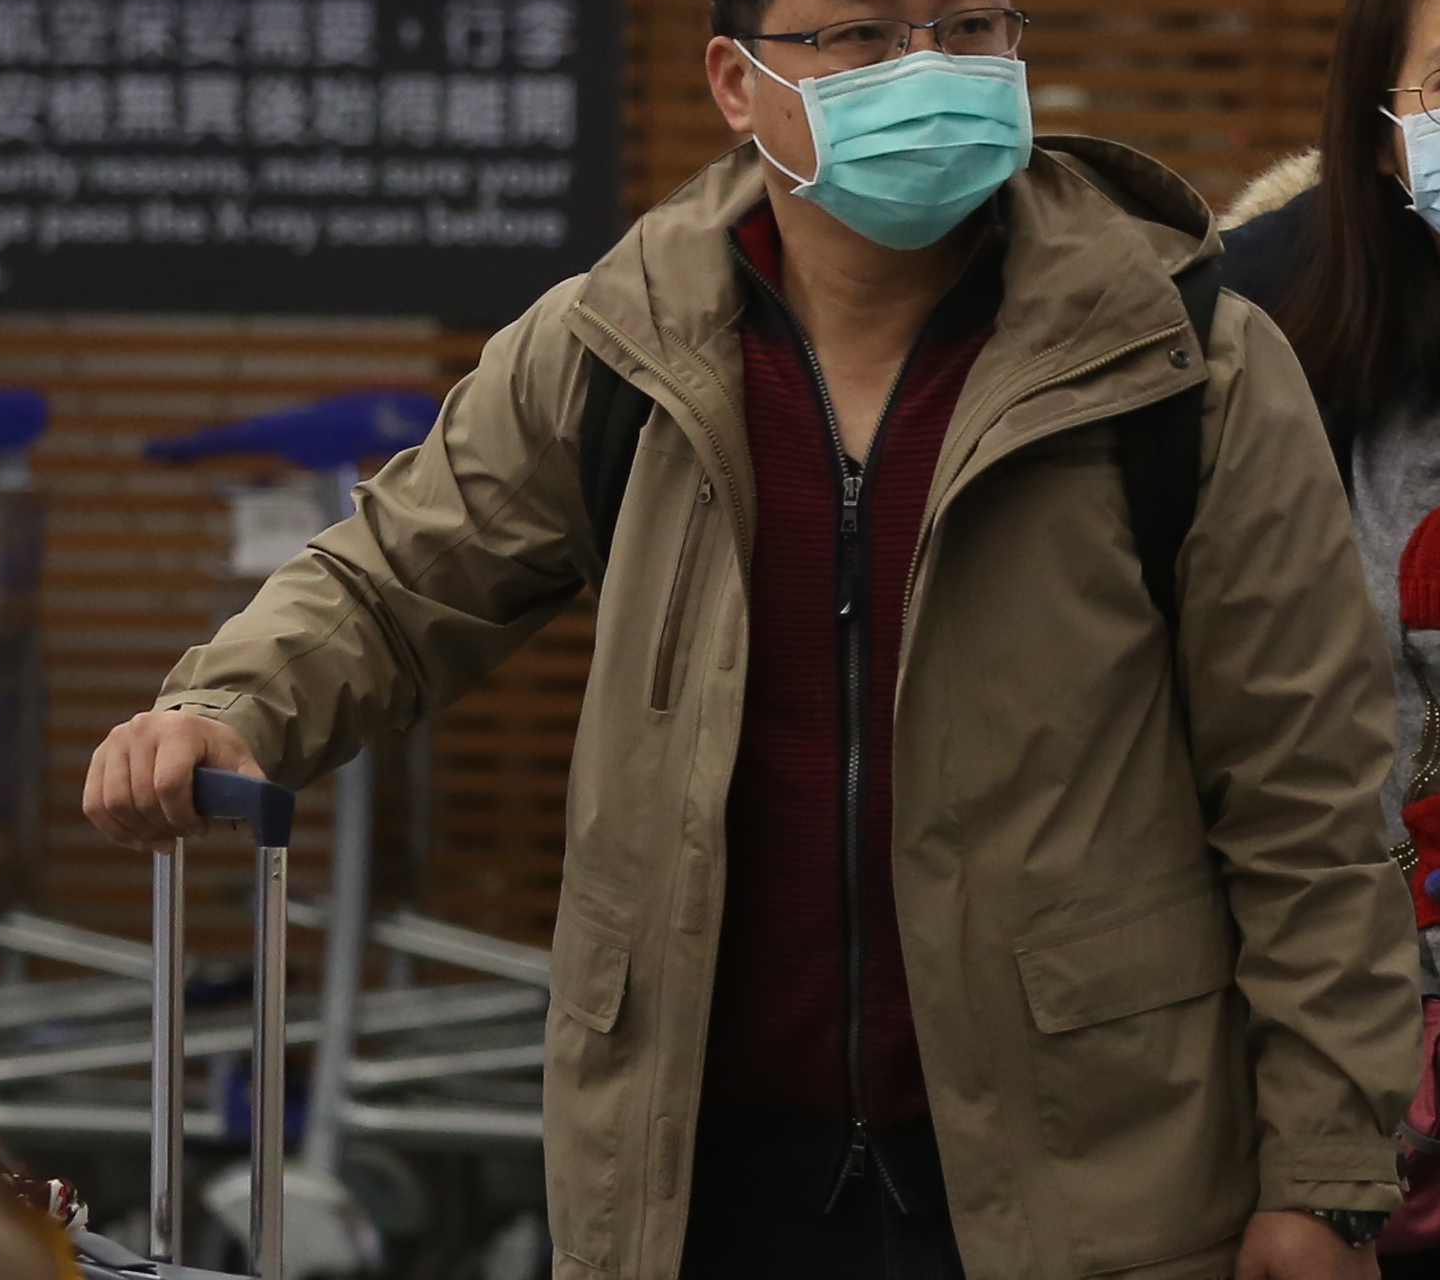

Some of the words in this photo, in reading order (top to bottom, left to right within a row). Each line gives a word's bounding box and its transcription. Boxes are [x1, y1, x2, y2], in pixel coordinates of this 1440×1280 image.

[259, 151, 373, 194] make
[382, 160, 471, 196] sure
[477, 159, 573, 207] your
[39, 207, 133, 252] pass
[139, 199, 208, 242] the
[326, 207, 420, 246] scan
[426, 199, 568, 247] before
